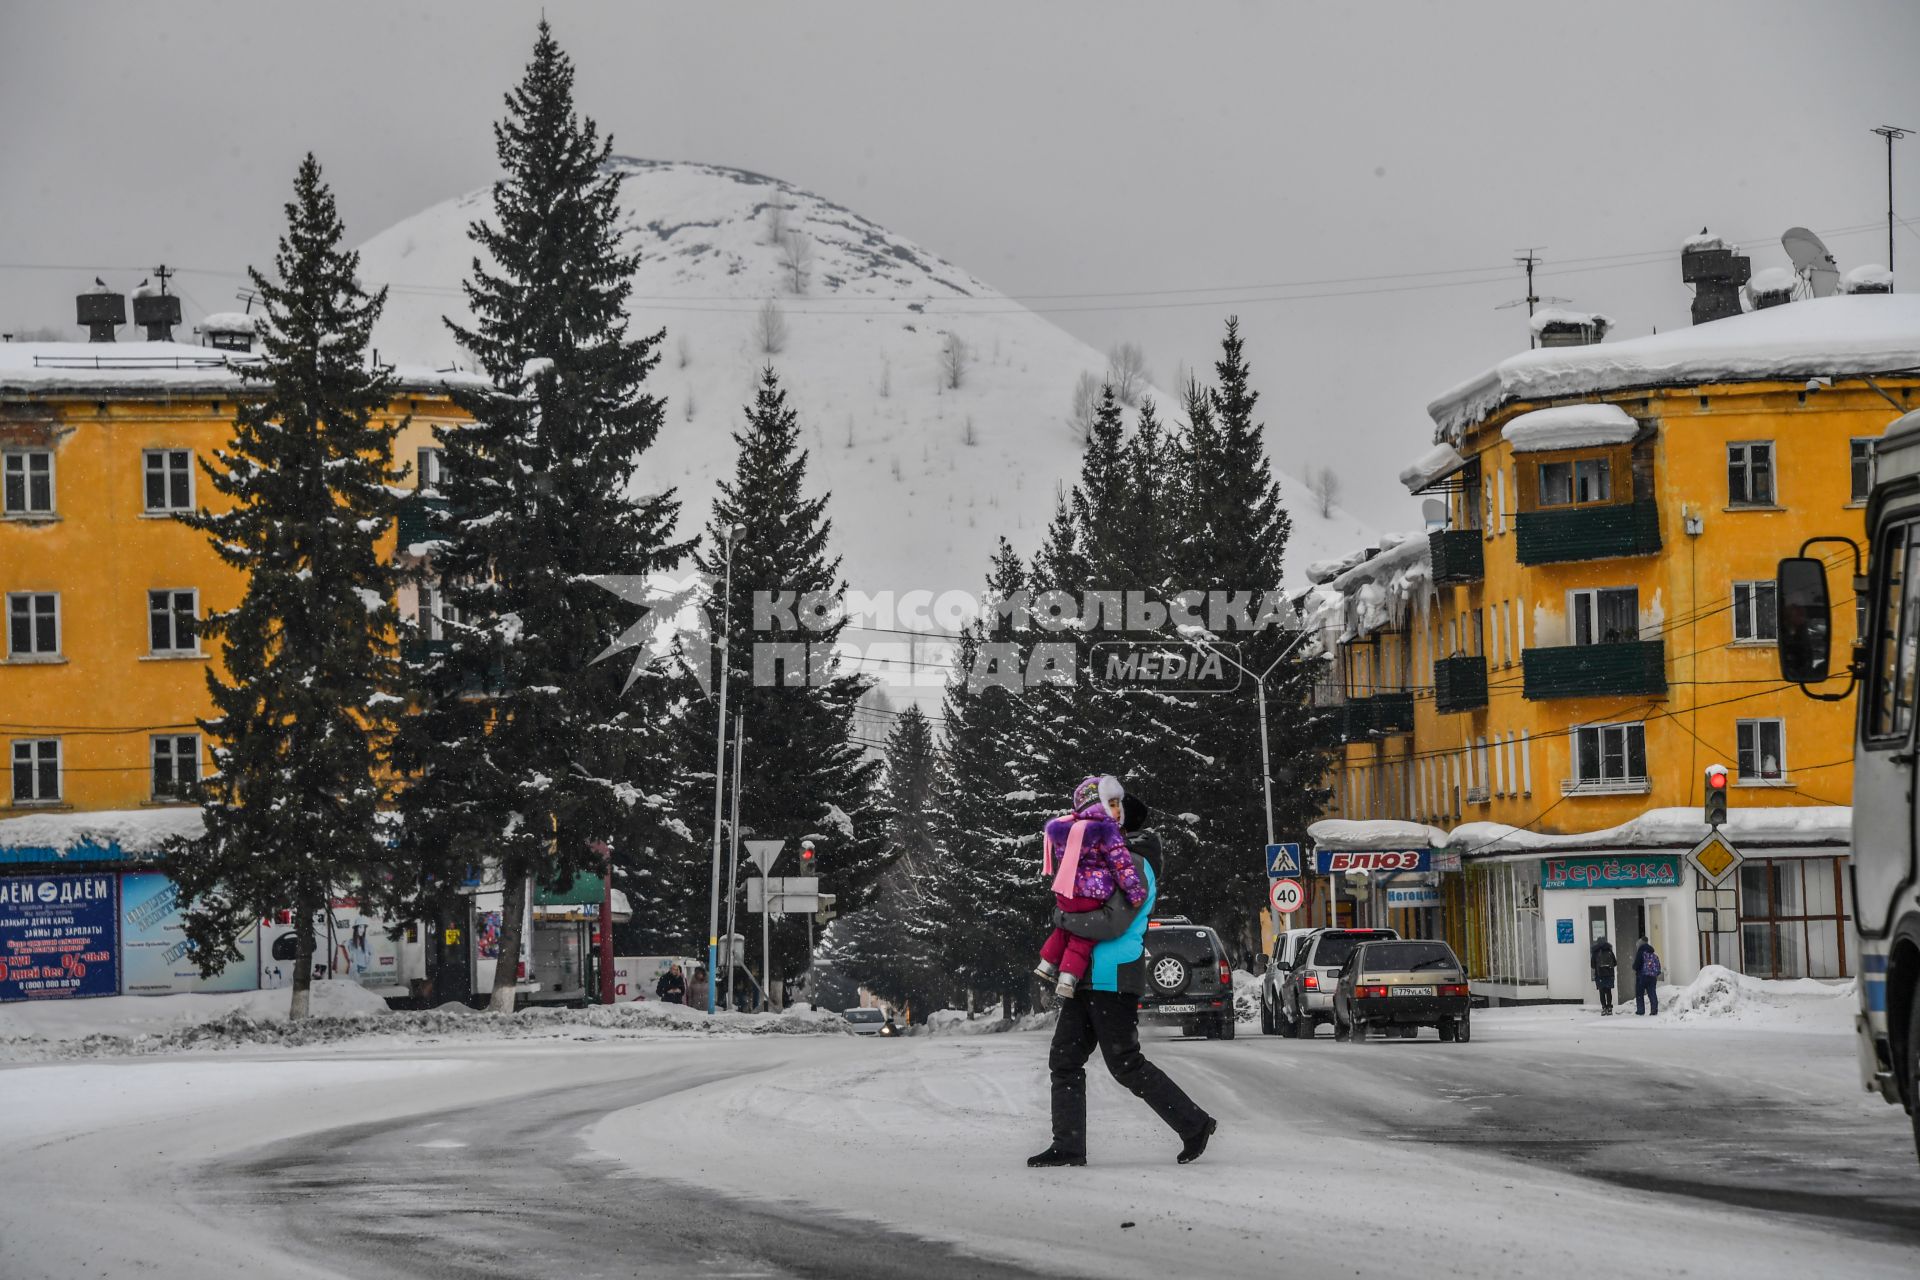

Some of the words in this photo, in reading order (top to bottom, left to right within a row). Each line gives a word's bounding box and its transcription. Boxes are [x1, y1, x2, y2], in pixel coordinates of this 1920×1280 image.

[1330, 852, 1420, 872] БЛЮЗ
[1546, 860, 1674, 887] Берёзка
[60, 879, 107, 903] ДАЁМ
[1277, 889, 1296, 903] 40
[25, 928, 51, 938] ЗАЙМЫ
[53, 928, 63, 937] ДО
[65, 926, 102, 936] ЗАРПЛАТЫ
